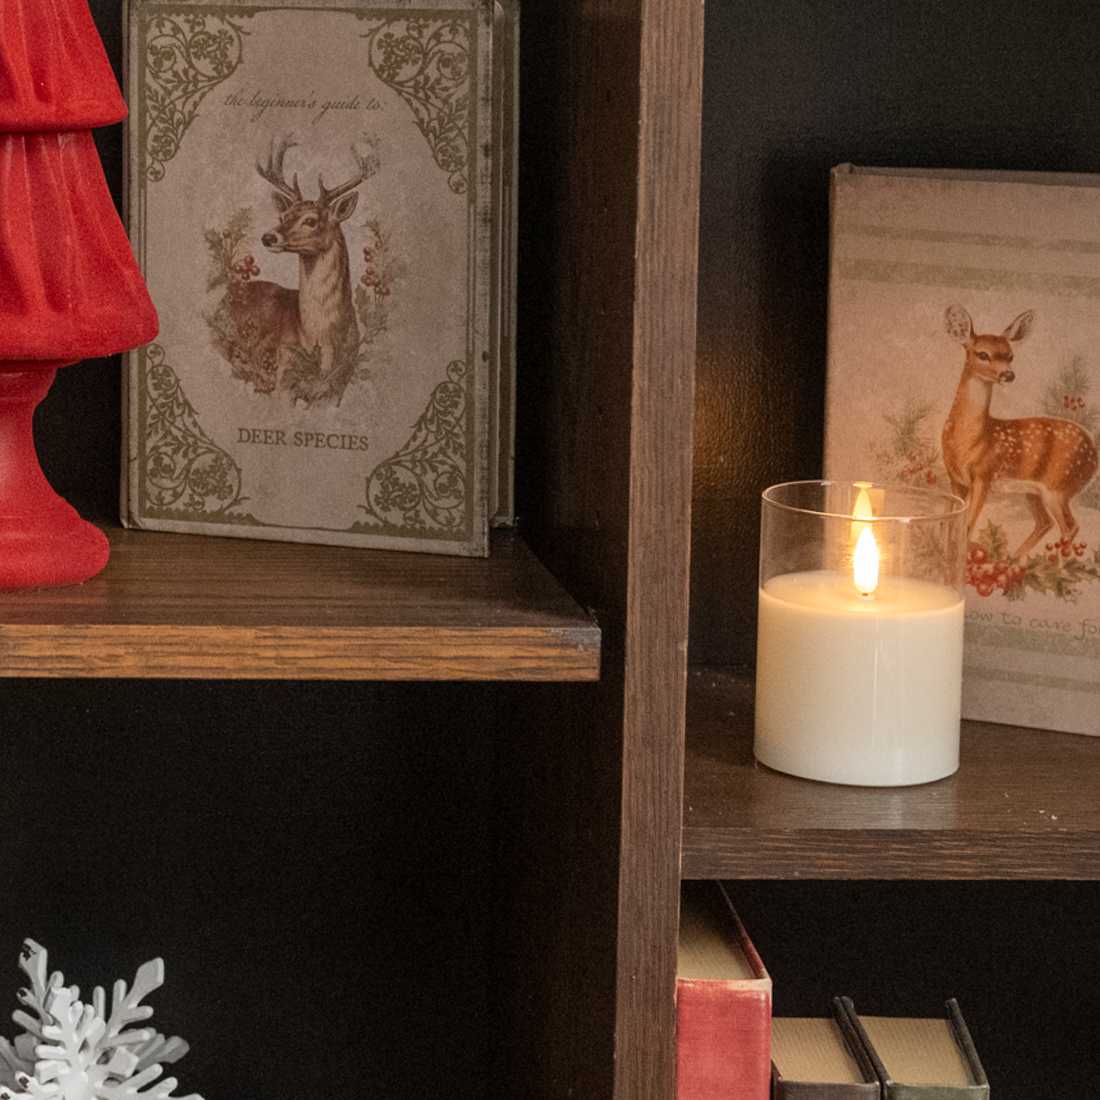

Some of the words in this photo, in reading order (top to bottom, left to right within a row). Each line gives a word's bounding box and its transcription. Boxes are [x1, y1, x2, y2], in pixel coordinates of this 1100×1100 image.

[224, 88, 244, 106] the
[250, 90, 317, 123] beginner's
[311, 95, 360, 125] guide
[237, 428, 287, 446] DEER
[293, 431, 369, 451] SPECIES
[964, 611, 994, 621] ow
[1000, 610, 1022, 626] to
[1029, 618, 1073, 633] care
[1074, 618, 1100, 641] fo
